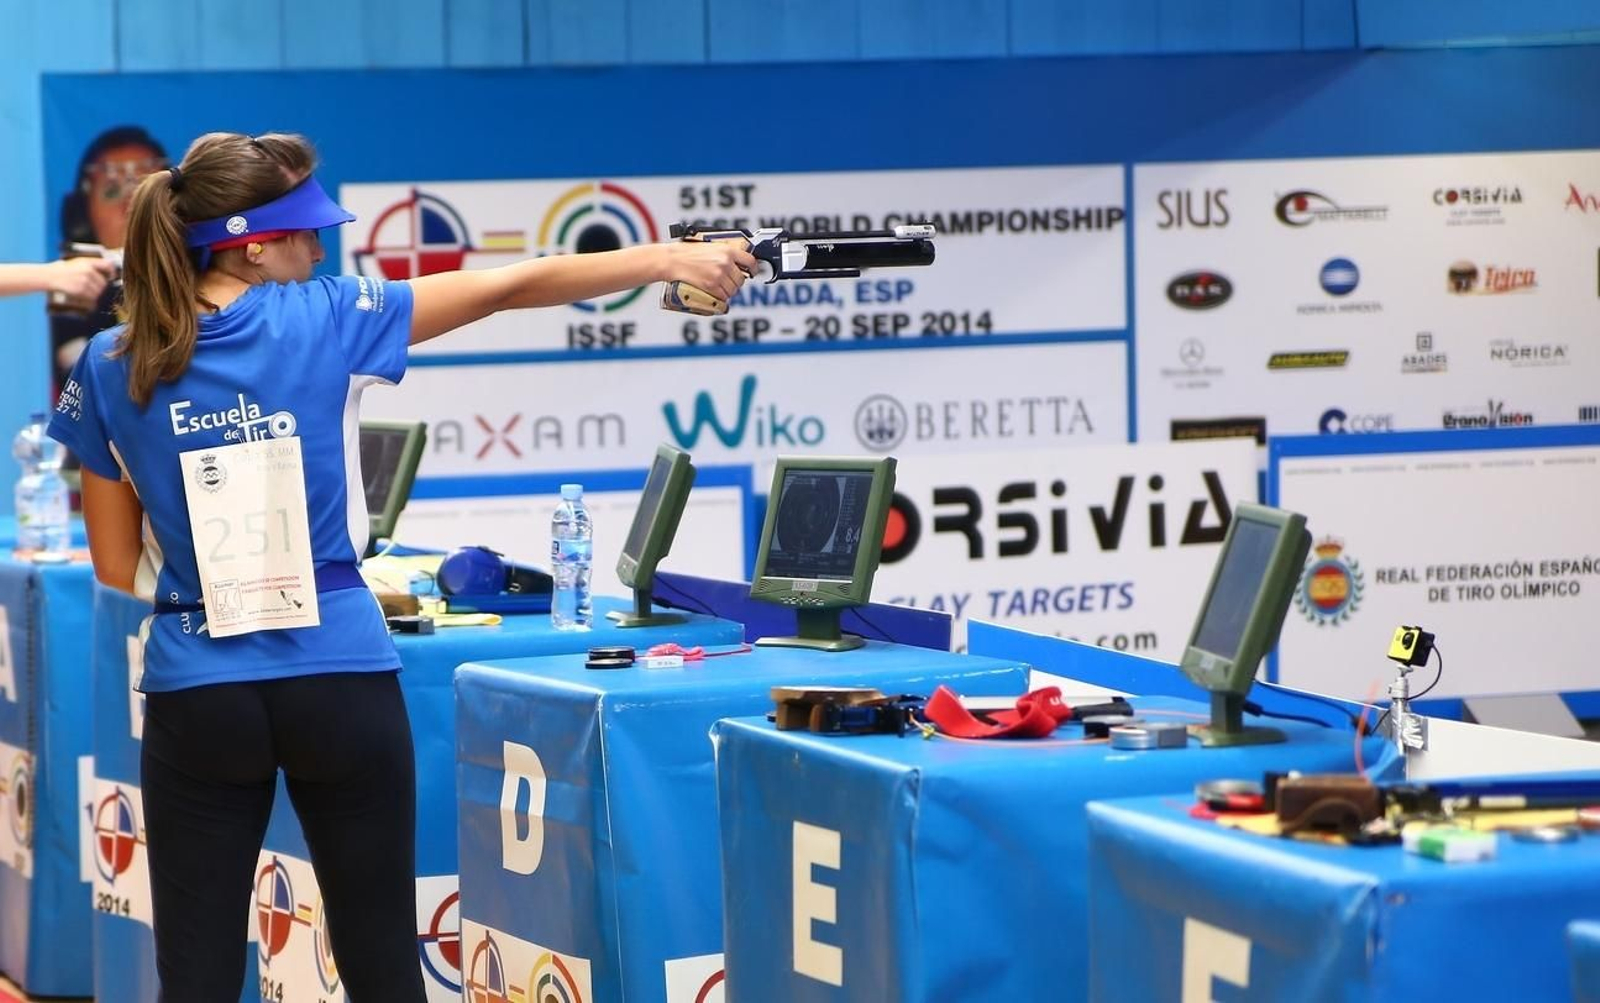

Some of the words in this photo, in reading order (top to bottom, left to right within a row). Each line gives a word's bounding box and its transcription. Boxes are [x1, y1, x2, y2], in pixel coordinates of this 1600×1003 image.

[679, 184, 755, 210] 51ST
[1156, 188, 1231, 230] SIUS
[883, 207, 1125, 236] CHAMPIONSHIP
[855, 279, 914, 304] ESP
[567, 322, 637, 350] ISSF
[682, 318, 700, 345] 6
[711, 317, 771, 343] SEP
[805, 315, 841, 341] 20
[851, 313, 911, 338] SEP
[921, 310, 994, 336] 2014
[169, 393, 261, 436] Escuela
[662, 373, 825, 450] Wiko
[914, 397, 1096, 442] BERETTA
[223, 429, 240, 441] de
[432, 412, 626, 461] AXAM
[204, 508, 291, 564] 251
[1375, 568, 1419, 585] REAL
[1425, 560, 1534, 583] FEDERACIÓN
[989, 582, 1136, 618] TARGETS
[1428, 587, 1450, 603] DE
[1456, 584, 1495, 601] TIRO
[1500, 579, 1581, 600] OLÍMPICO
[501, 739, 548, 876] D
[96, 892, 132, 917] 2014
[792, 820, 844, 988] E
[261, 975, 284, 1003] 014
